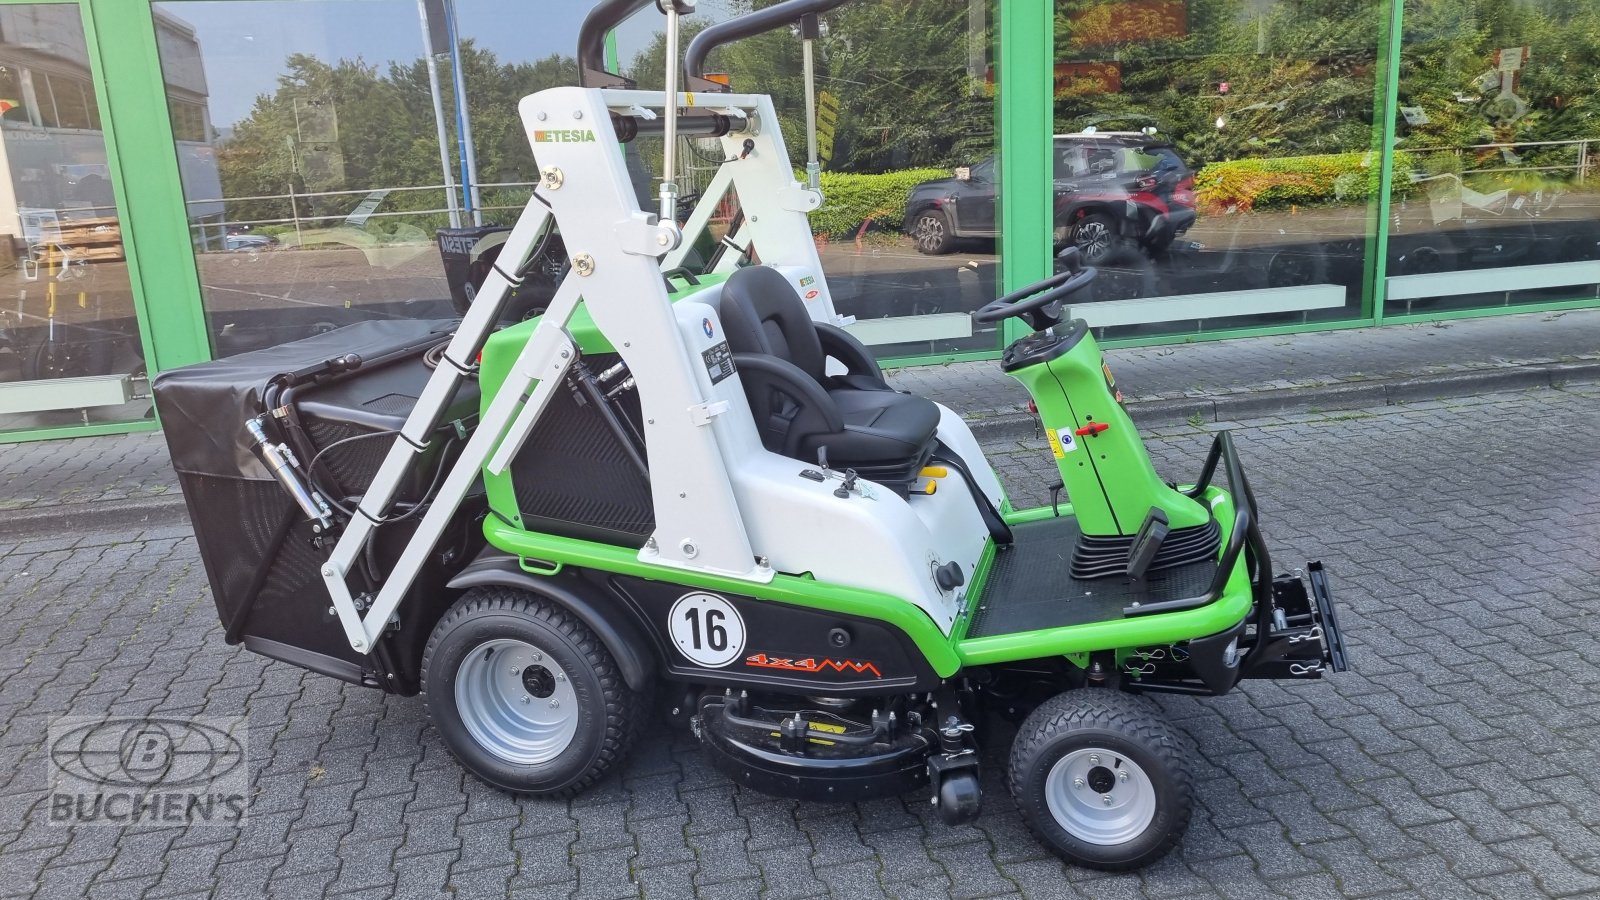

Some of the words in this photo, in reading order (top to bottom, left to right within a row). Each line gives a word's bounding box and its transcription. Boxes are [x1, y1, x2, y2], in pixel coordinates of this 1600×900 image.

[544, 129, 596, 142] ETESIA
[685, 607, 728, 652] 16
[746, 653, 817, 669] 4x4
